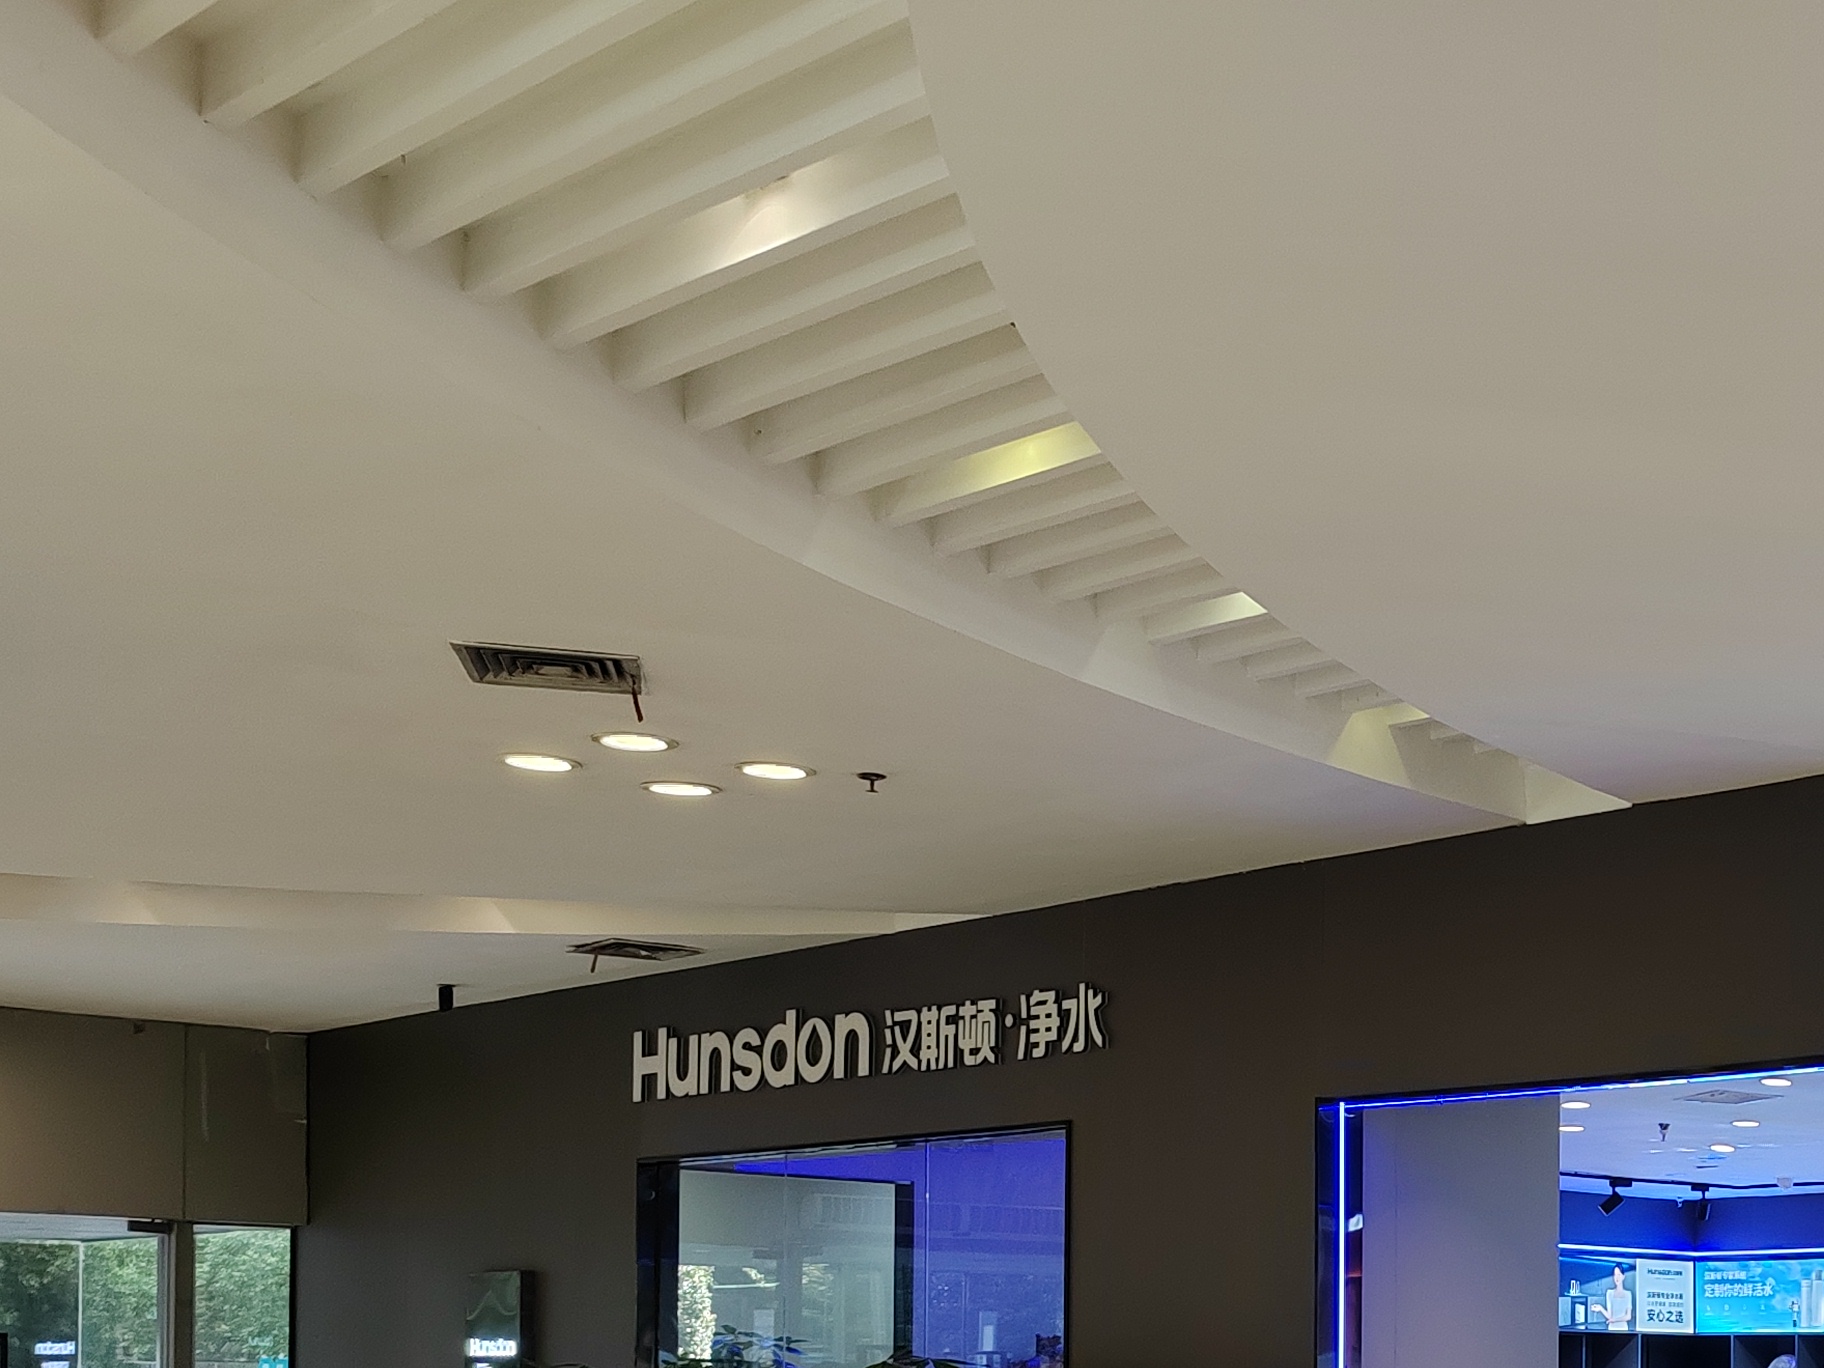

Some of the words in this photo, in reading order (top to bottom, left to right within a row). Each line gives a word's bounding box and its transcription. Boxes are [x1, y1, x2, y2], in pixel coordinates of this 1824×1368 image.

[632, 1008, 871, 1102] Hunsdon
[881, 982, 1106, 1075] 汉斯顿·净水
